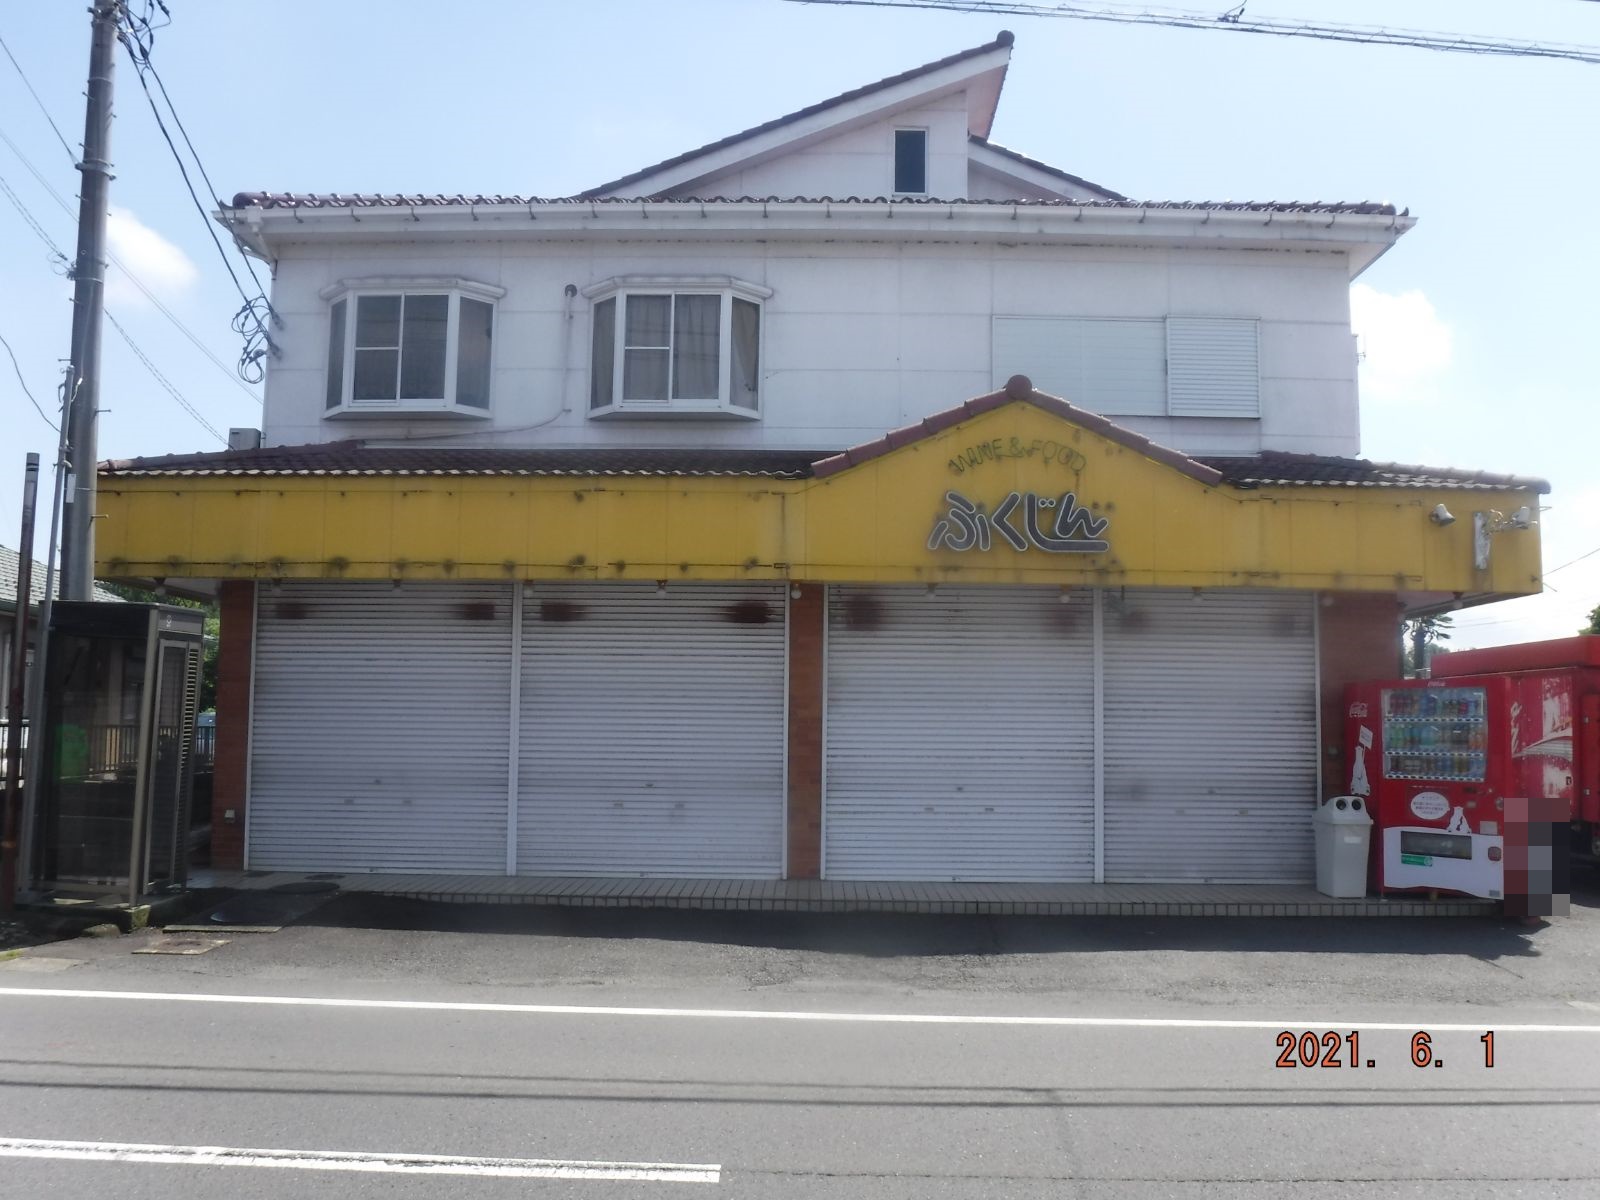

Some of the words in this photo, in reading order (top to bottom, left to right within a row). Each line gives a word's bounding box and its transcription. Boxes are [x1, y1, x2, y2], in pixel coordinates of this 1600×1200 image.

[1009, 436, 1024, 456] &
[927, 491, 1109, 552] ふくじん
